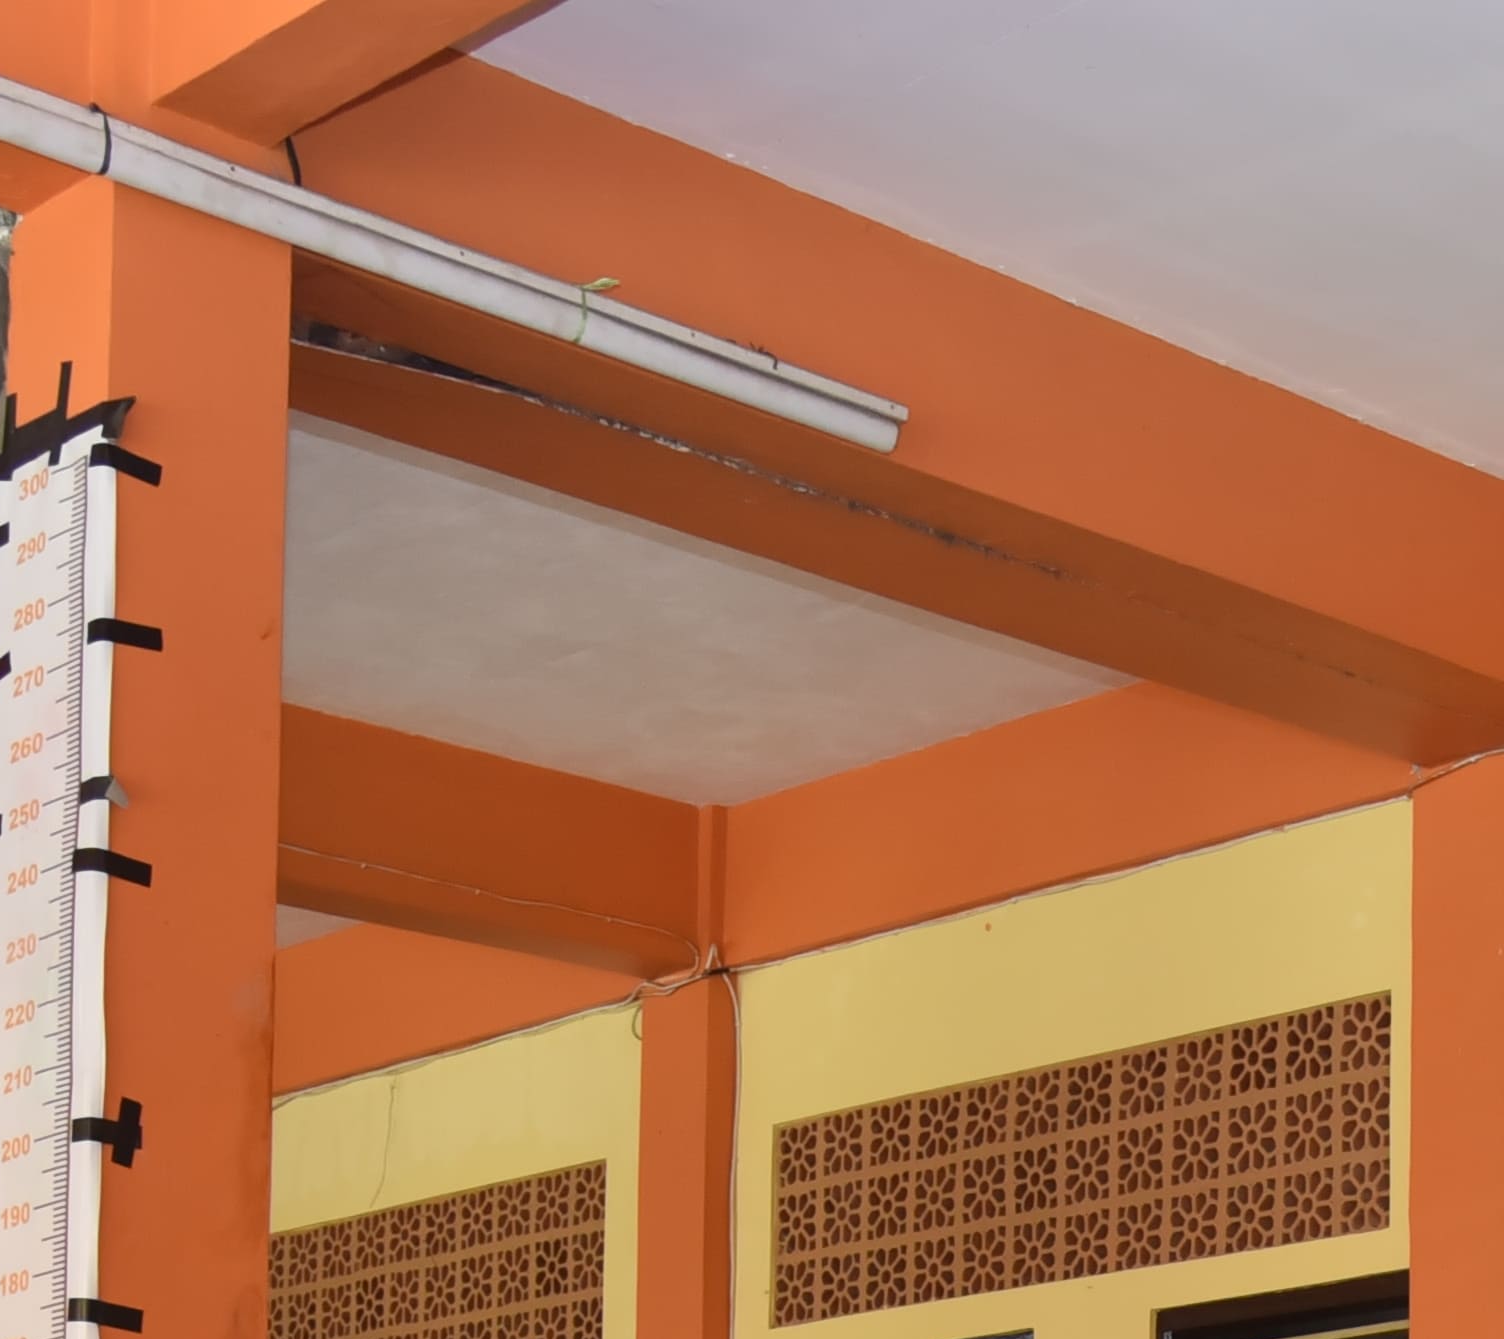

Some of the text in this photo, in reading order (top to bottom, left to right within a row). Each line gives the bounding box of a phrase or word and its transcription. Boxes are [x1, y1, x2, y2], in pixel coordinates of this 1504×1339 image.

[18, 467, 50, 501] 300
[16, 532, 47, 565] 290
[13, 597, 45, 631] 280
[12, 665, 45, 698] 270
[9, 731, 44, 764] 260
[8, 799, 41, 831] 250
[7, 863, 39, 895] 240
[5, 933, 37, 965] 230
[3, 1000, 36, 1031] 220
[2, 1067, 34, 1095] 210
[0, 1133, 32, 1163] 200
[0, 1201, 31, 1231] 190
